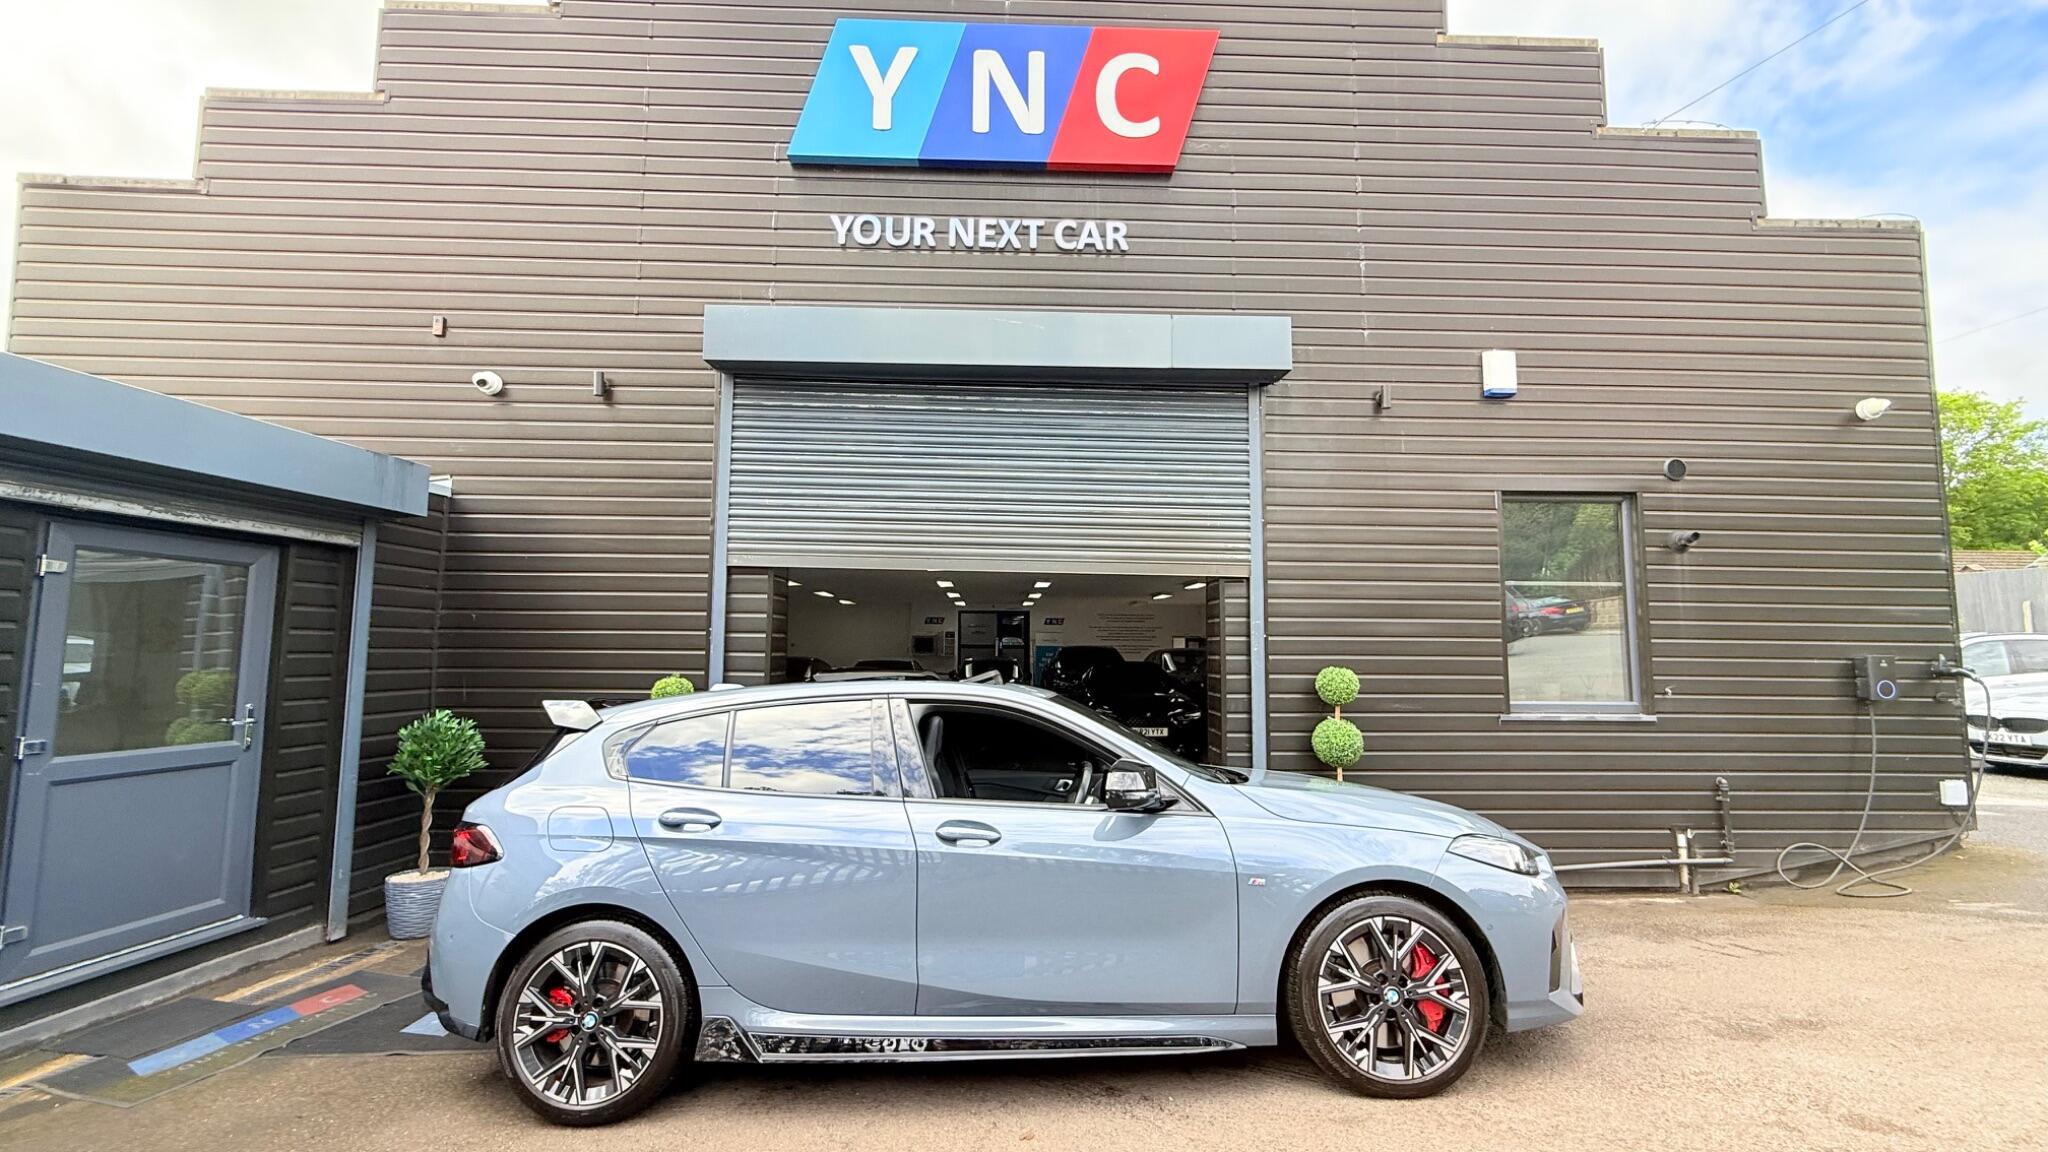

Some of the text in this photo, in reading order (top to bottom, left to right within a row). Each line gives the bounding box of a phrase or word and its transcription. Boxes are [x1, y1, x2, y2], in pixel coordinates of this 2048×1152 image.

[849, 45, 1160, 138] YNC
[830, 214, 1129, 252] YOUR NEXT CAR
[2008, 735, 2026, 743] YTA
